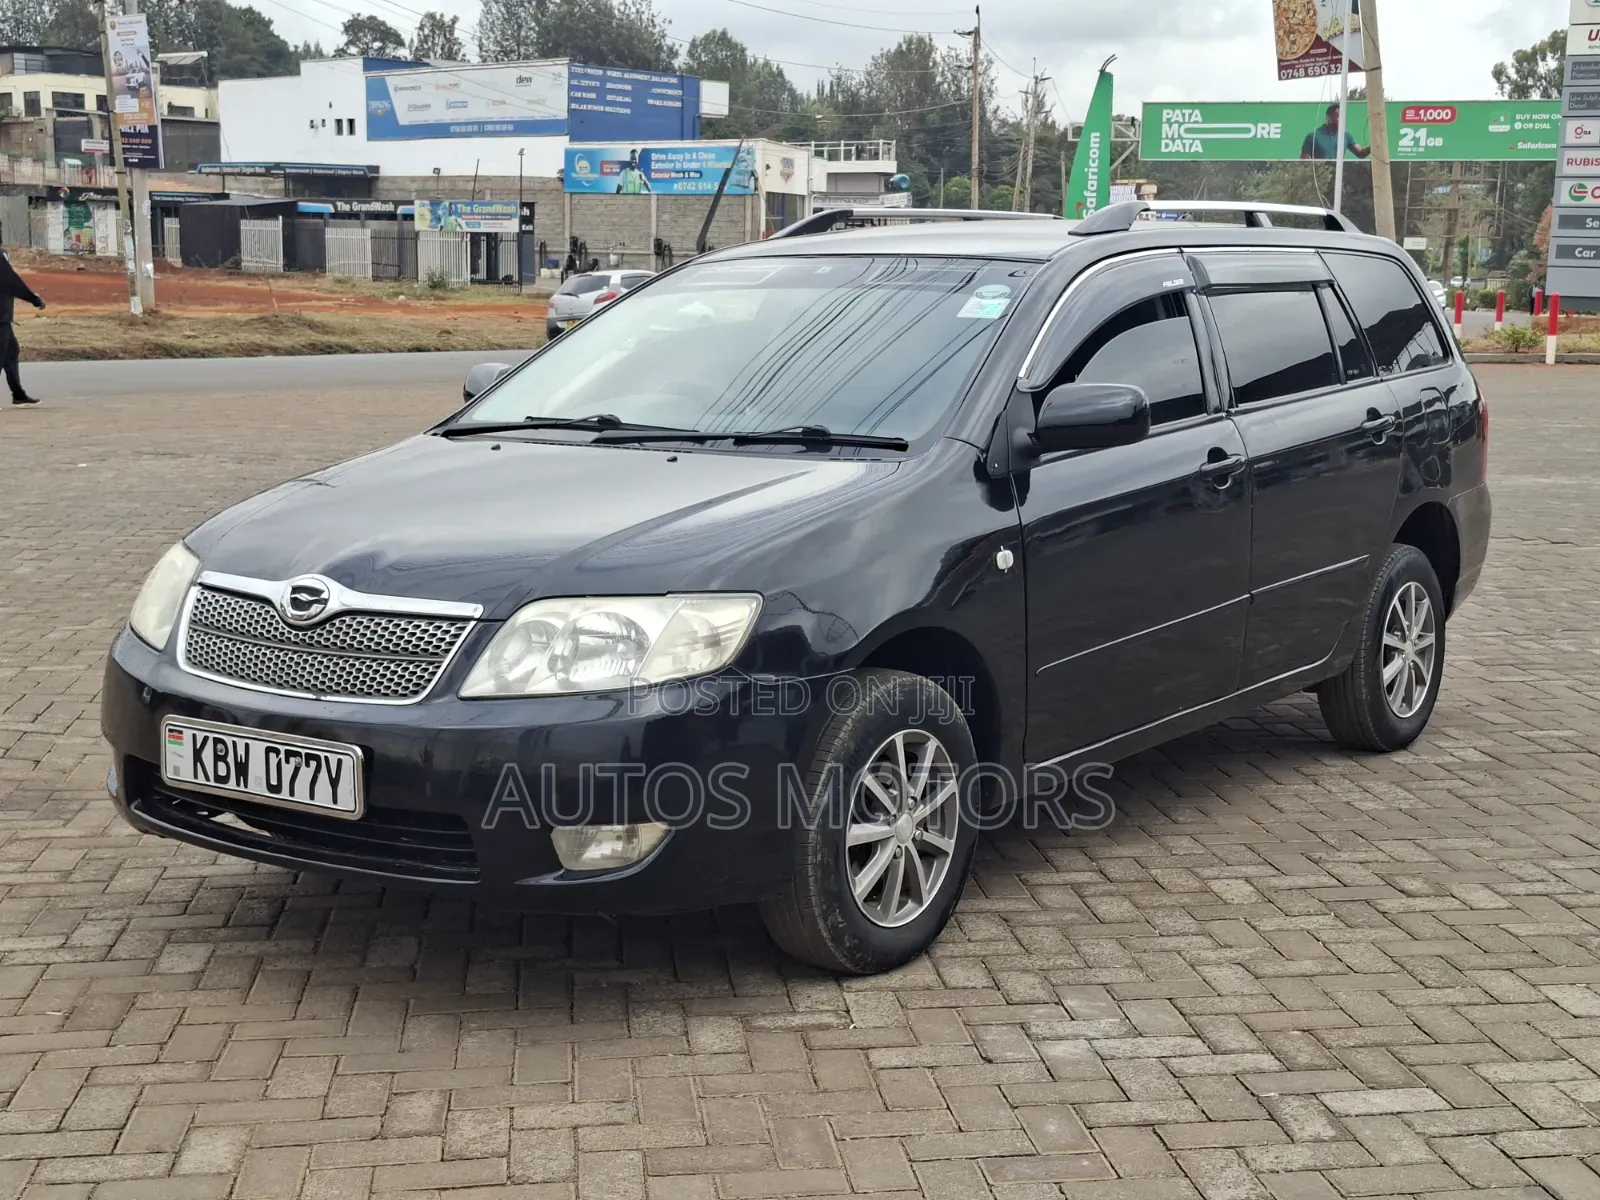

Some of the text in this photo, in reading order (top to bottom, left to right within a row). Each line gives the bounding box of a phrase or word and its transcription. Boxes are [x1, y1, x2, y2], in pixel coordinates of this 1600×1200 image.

[1280, 63, 1342, 79] 0748 690 32
[1162, 109, 1203, 122] PATA
[1419, 109, 1452, 122] 1,000
[1162, 123, 1282, 139] MORE
[1161, 139, 1203, 153] DATA
[1517, 141, 1557, 149] Safaricom
[667, 152, 683, 161] Away
[1566, 157, 1600, 167] RUBIS
[1083, 132, 1101, 219] Safaricom
[336, 201, 395, 212] The GrandWash
[457, 204, 517, 214] The GrandWash
[1574, 247, 1596, 258] Car
[192, 733, 343, 805] KBW 077Y
